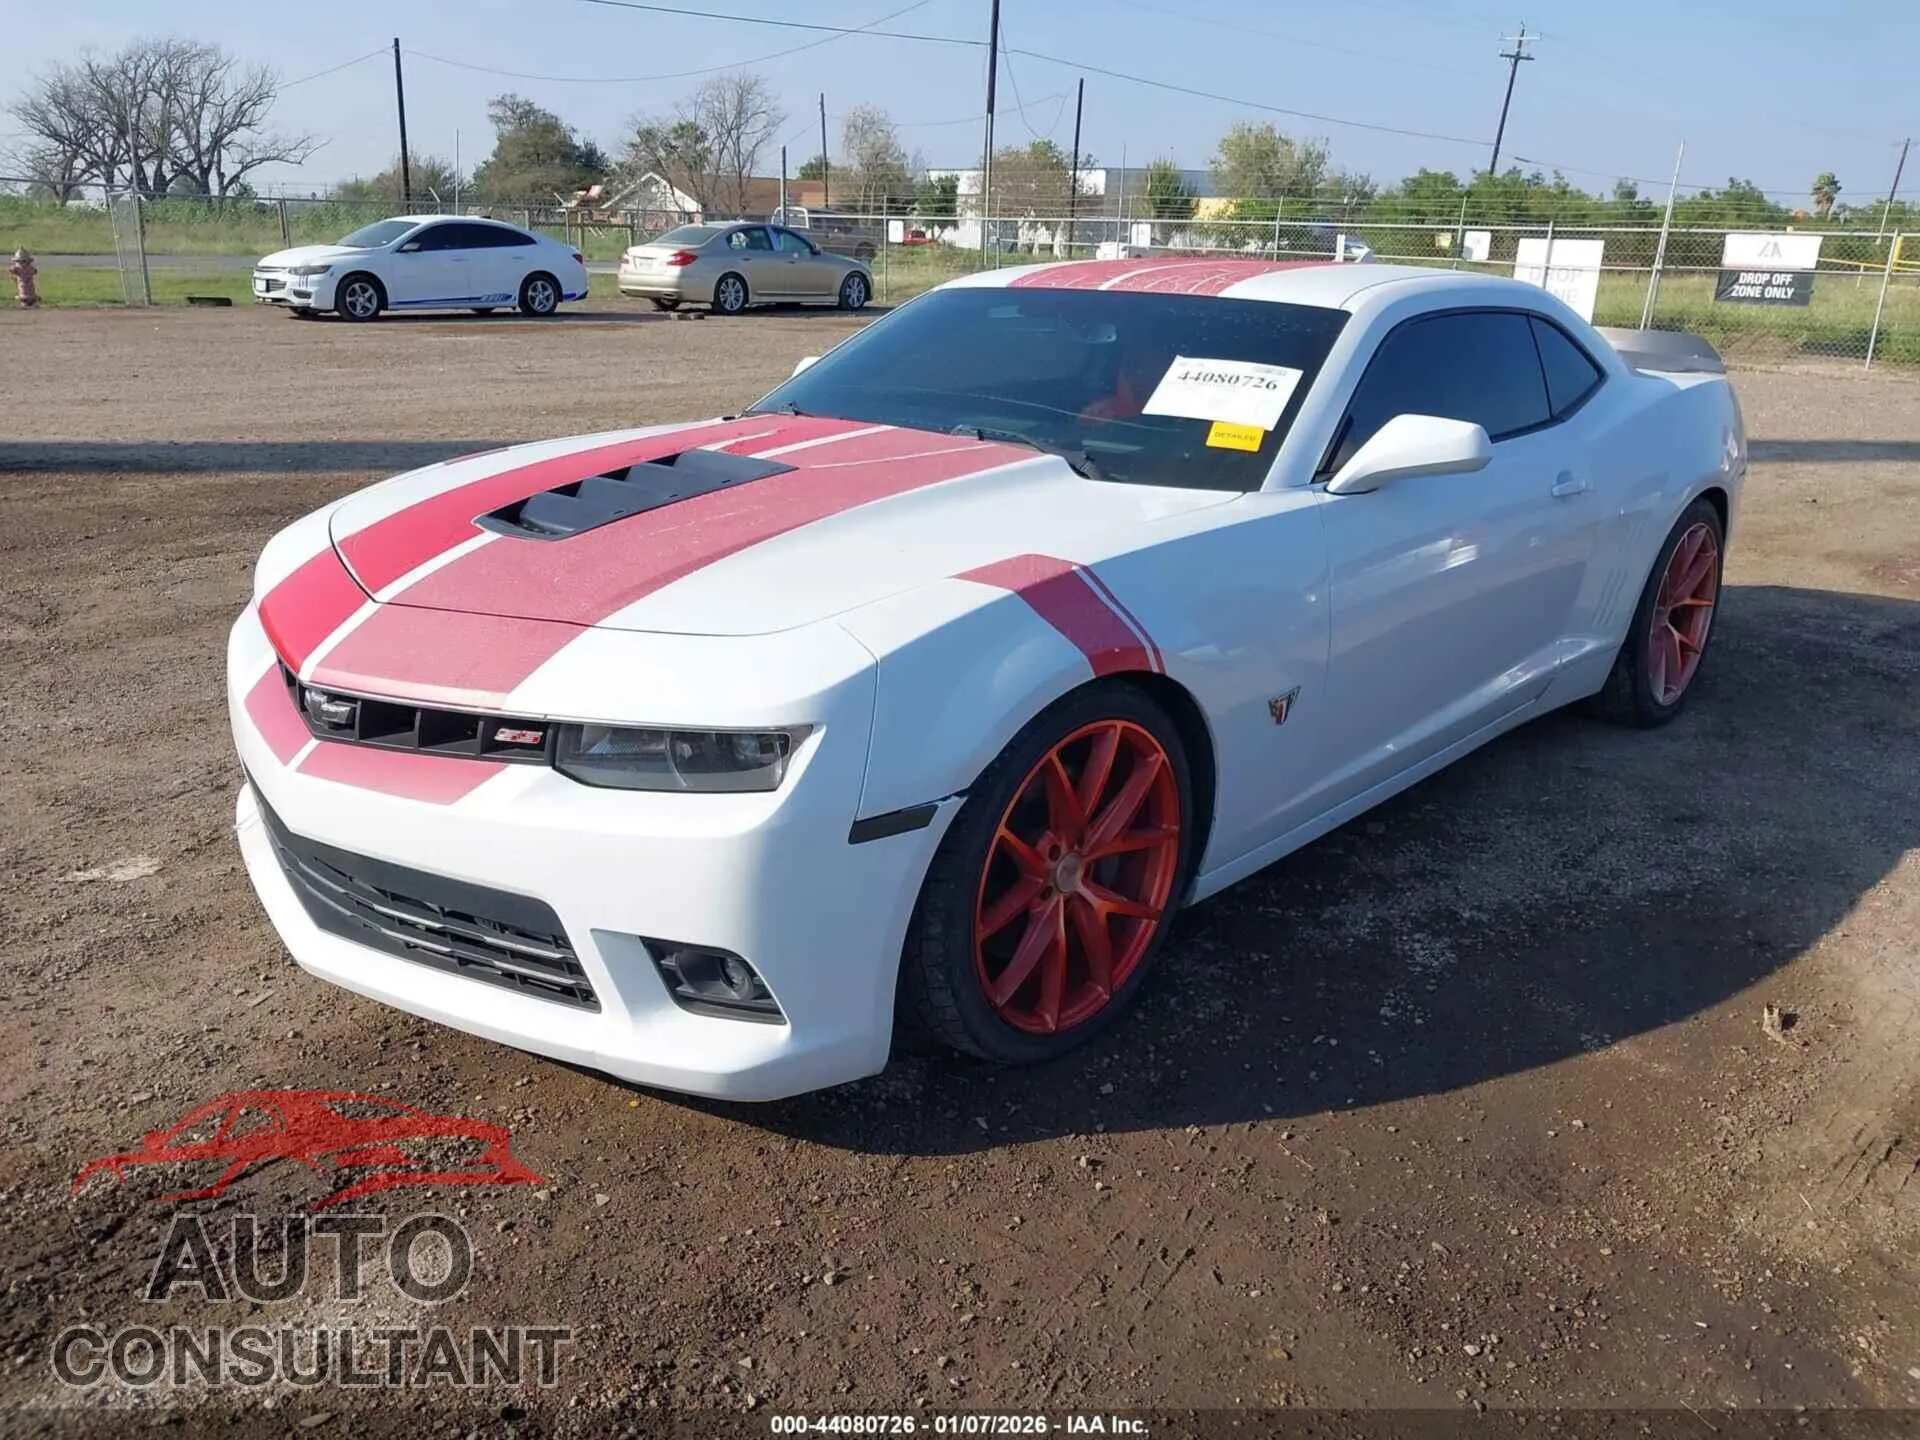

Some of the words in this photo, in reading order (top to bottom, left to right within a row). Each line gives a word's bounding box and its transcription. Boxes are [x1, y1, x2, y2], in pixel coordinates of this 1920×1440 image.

[1738, 272, 1770, 285] DROP
[1771, 273, 1794, 286] OFF
[1731, 285, 1763, 298] ZONE
[1764, 286, 1795, 299] ONLY
[1177, 369, 1278, 391] 44080726
